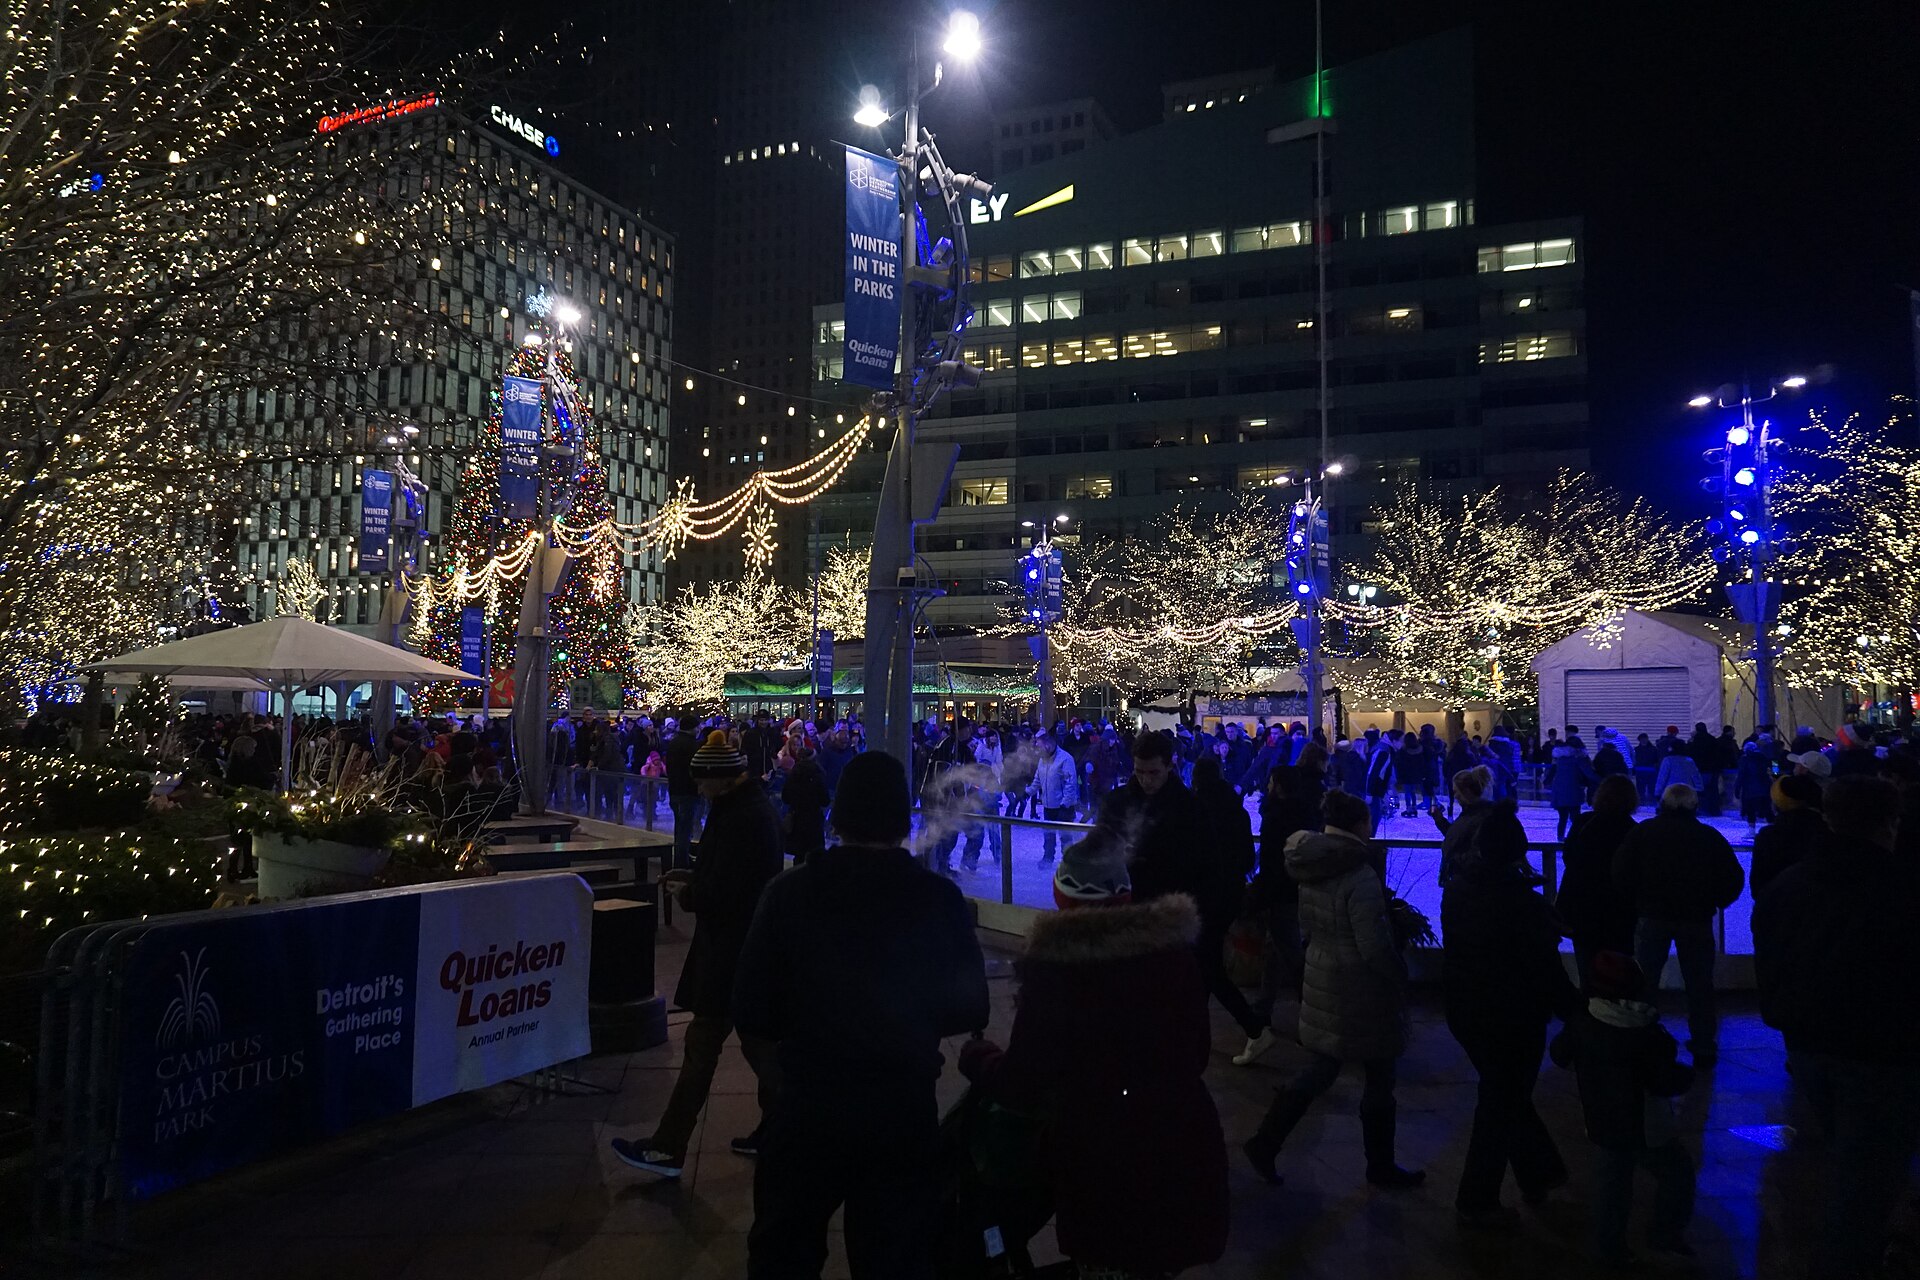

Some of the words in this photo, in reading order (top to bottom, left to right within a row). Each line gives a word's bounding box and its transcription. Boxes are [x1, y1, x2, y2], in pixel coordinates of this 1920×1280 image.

[490, 104, 545, 150] CHASE
[970, 193, 1010, 225] EY
[850, 232, 898, 258] WINTER
[853, 254, 868, 273] IN
[871, 258, 896, 279] THE
[854, 277, 894, 300] PARKS
[848, 339, 894, 359] Quicken
[854, 351, 888, 369] Loans
[504, 427, 538, 441] WINTER
[363, 507, 389, 516] WINTER
[365, 516, 374, 525] IN
[374, 517, 387, 526] THE
[365, 526, 386, 535] PARKS
[440, 940, 566, 993] Quicken
[316, 974, 404, 1015] Detroit's
[456, 980, 552, 1027] Loans
[325, 1006, 403, 1038] Gathering
[468, 1028, 505, 1049] Annual
[506, 1020, 540, 1039] Partner
[355, 1030, 401, 1055] Place
[155, 1034, 263, 1079] CAMPUS
[156, 1049, 305, 1117] MARTIUS
[154, 1104, 217, 1143] PARK
